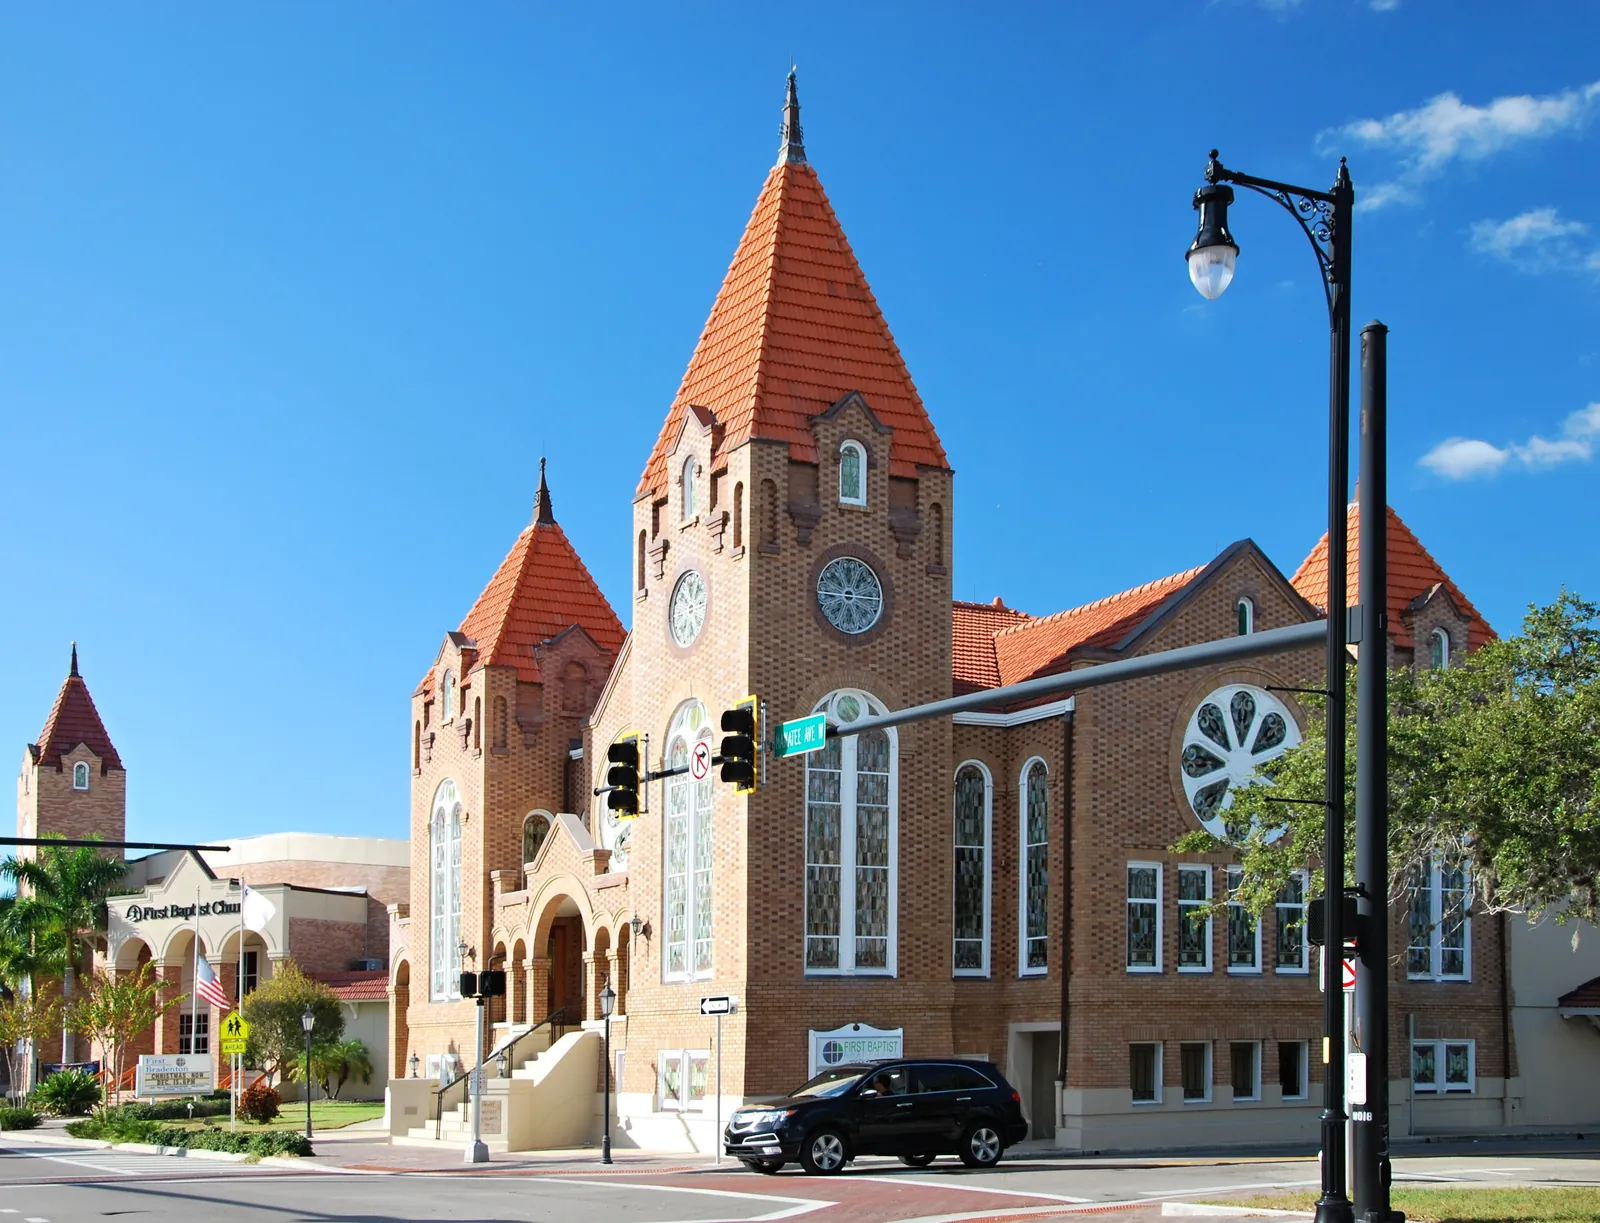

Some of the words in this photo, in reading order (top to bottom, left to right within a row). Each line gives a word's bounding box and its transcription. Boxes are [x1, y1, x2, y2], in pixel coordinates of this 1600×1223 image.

[804, 725, 815, 743] AVE
[143, 906, 168, 920] First
[170, 902, 210, 920] Baptst
[225, 1043, 243, 1051] AHEAD
[844, 1041, 866, 1053] FIRST
[868, 1041, 898, 1053] BAPTIST
